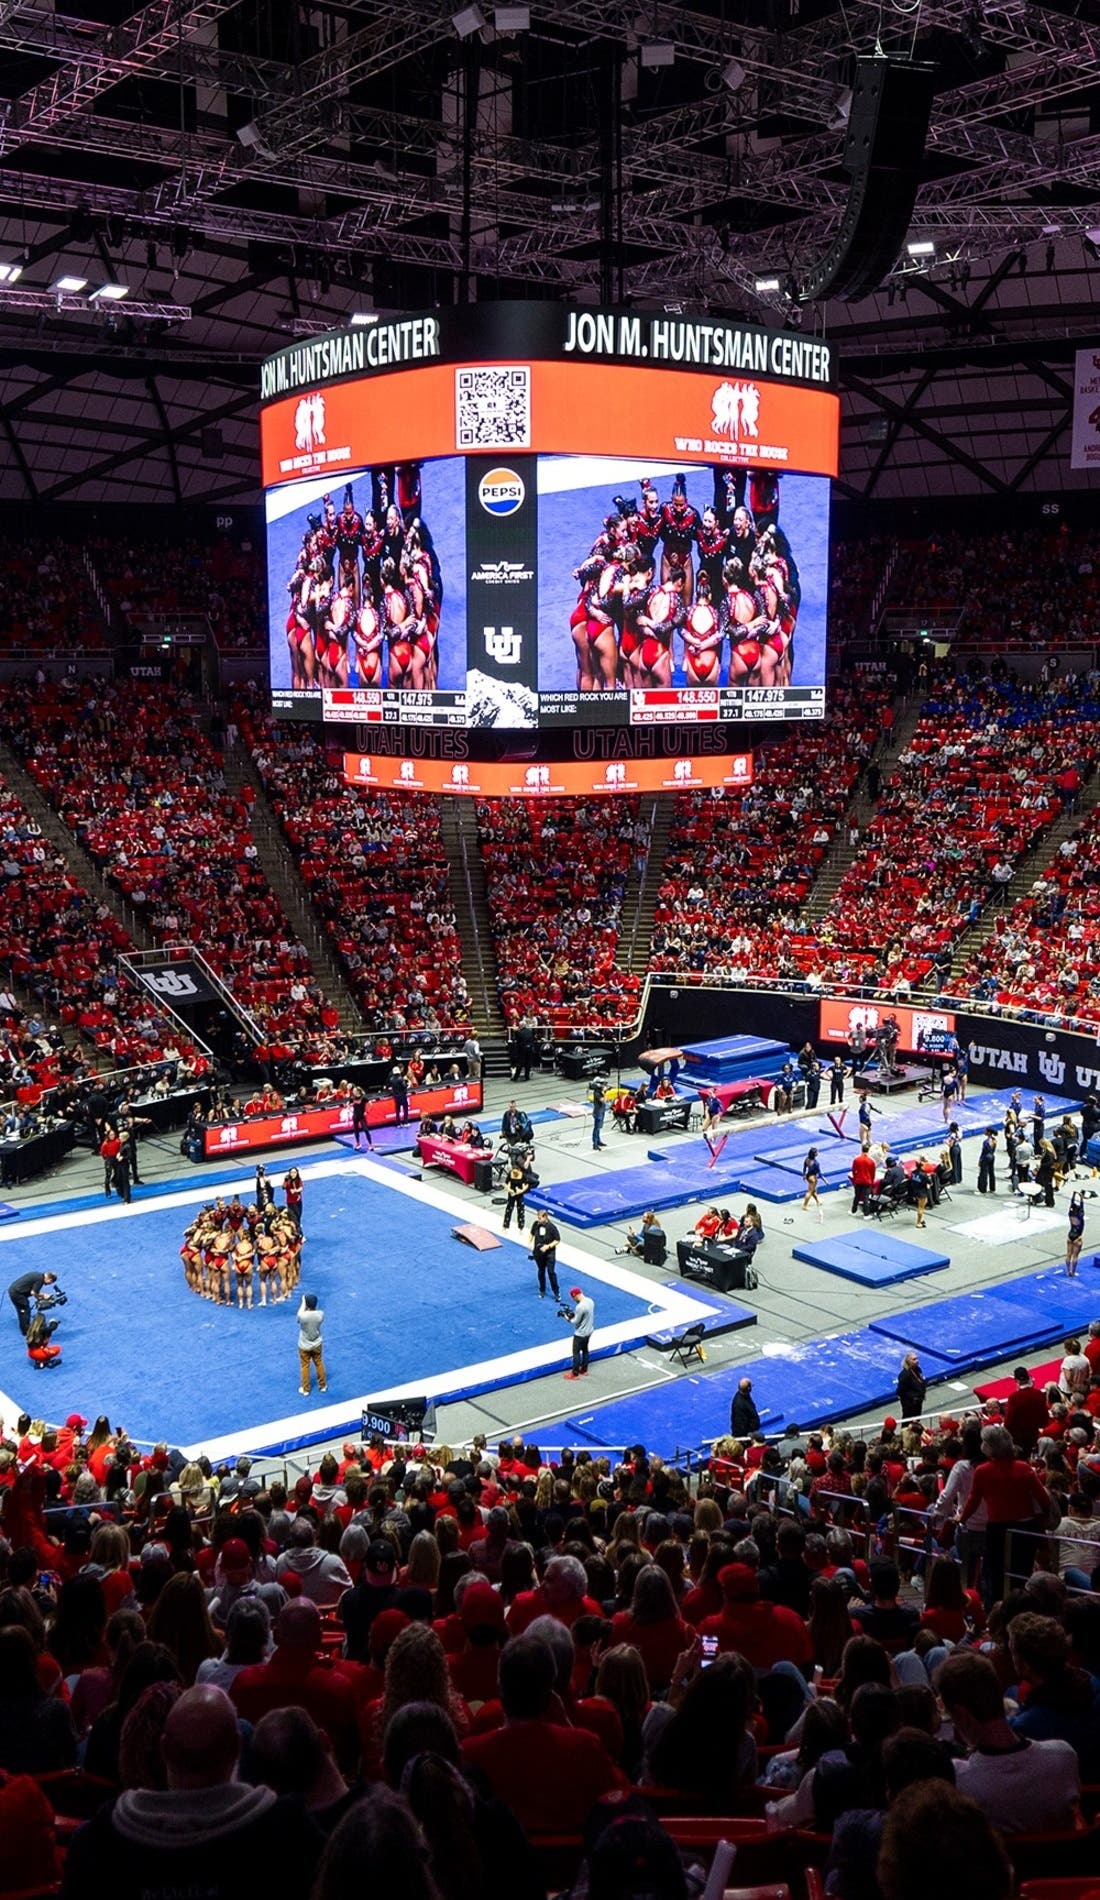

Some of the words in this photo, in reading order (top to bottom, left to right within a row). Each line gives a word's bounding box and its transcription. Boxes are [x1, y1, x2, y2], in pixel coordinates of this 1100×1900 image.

[564, 312, 614, 354] JON
[620, 316, 648, 357] M.
[652, 320, 767, 372] HUNTSMAN
[771, 337, 831, 382] CENTER
[260, 360, 276, 400] JON
[277, 356, 289, 391] M.
[290, 332, 364, 385] HUNTSMAN
[367, 317, 437, 367] CENTER
[675, 437, 702, 452] WHO
[703, 440, 737, 455] ROCKS
[739, 443, 758, 457] THE
[482, 487, 521, 497] PEPSI
[1042, 504, 1060, 514] SS
[471, 571, 508, 580] AMERICA
[509, 571, 534, 580] FIRST
[854, 662, 887, 671] UTAH
[1050, 658, 1057, 667] S
[68, 665, 76, 674] N
[130, 666, 162, 677] UTAH
[402, 693, 433, 706] 147.975
[540, 694, 563, 702] WHICH
[564, 693, 579, 701] RED
[580, 693, 600, 701] ROCK
[614, 692, 628, 700] ARE
[677, 691, 717, 704] 148.550
[747, 690, 785, 702] 147.975
[561, 705, 577, 713] LIKE:
[723, 709, 739, 717] 37.1
[384, 711, 397, 720] 37.1
[356, 725, 406, 755] UTAH
[409, 727, 470, 759] UTES
[572, 726, 655, 760] UTAH
[661, 724, 728, 756] UTES
[969, 1045, 1028, 1074] UTAH
[362, 1413, 390, 1434] 9.900
